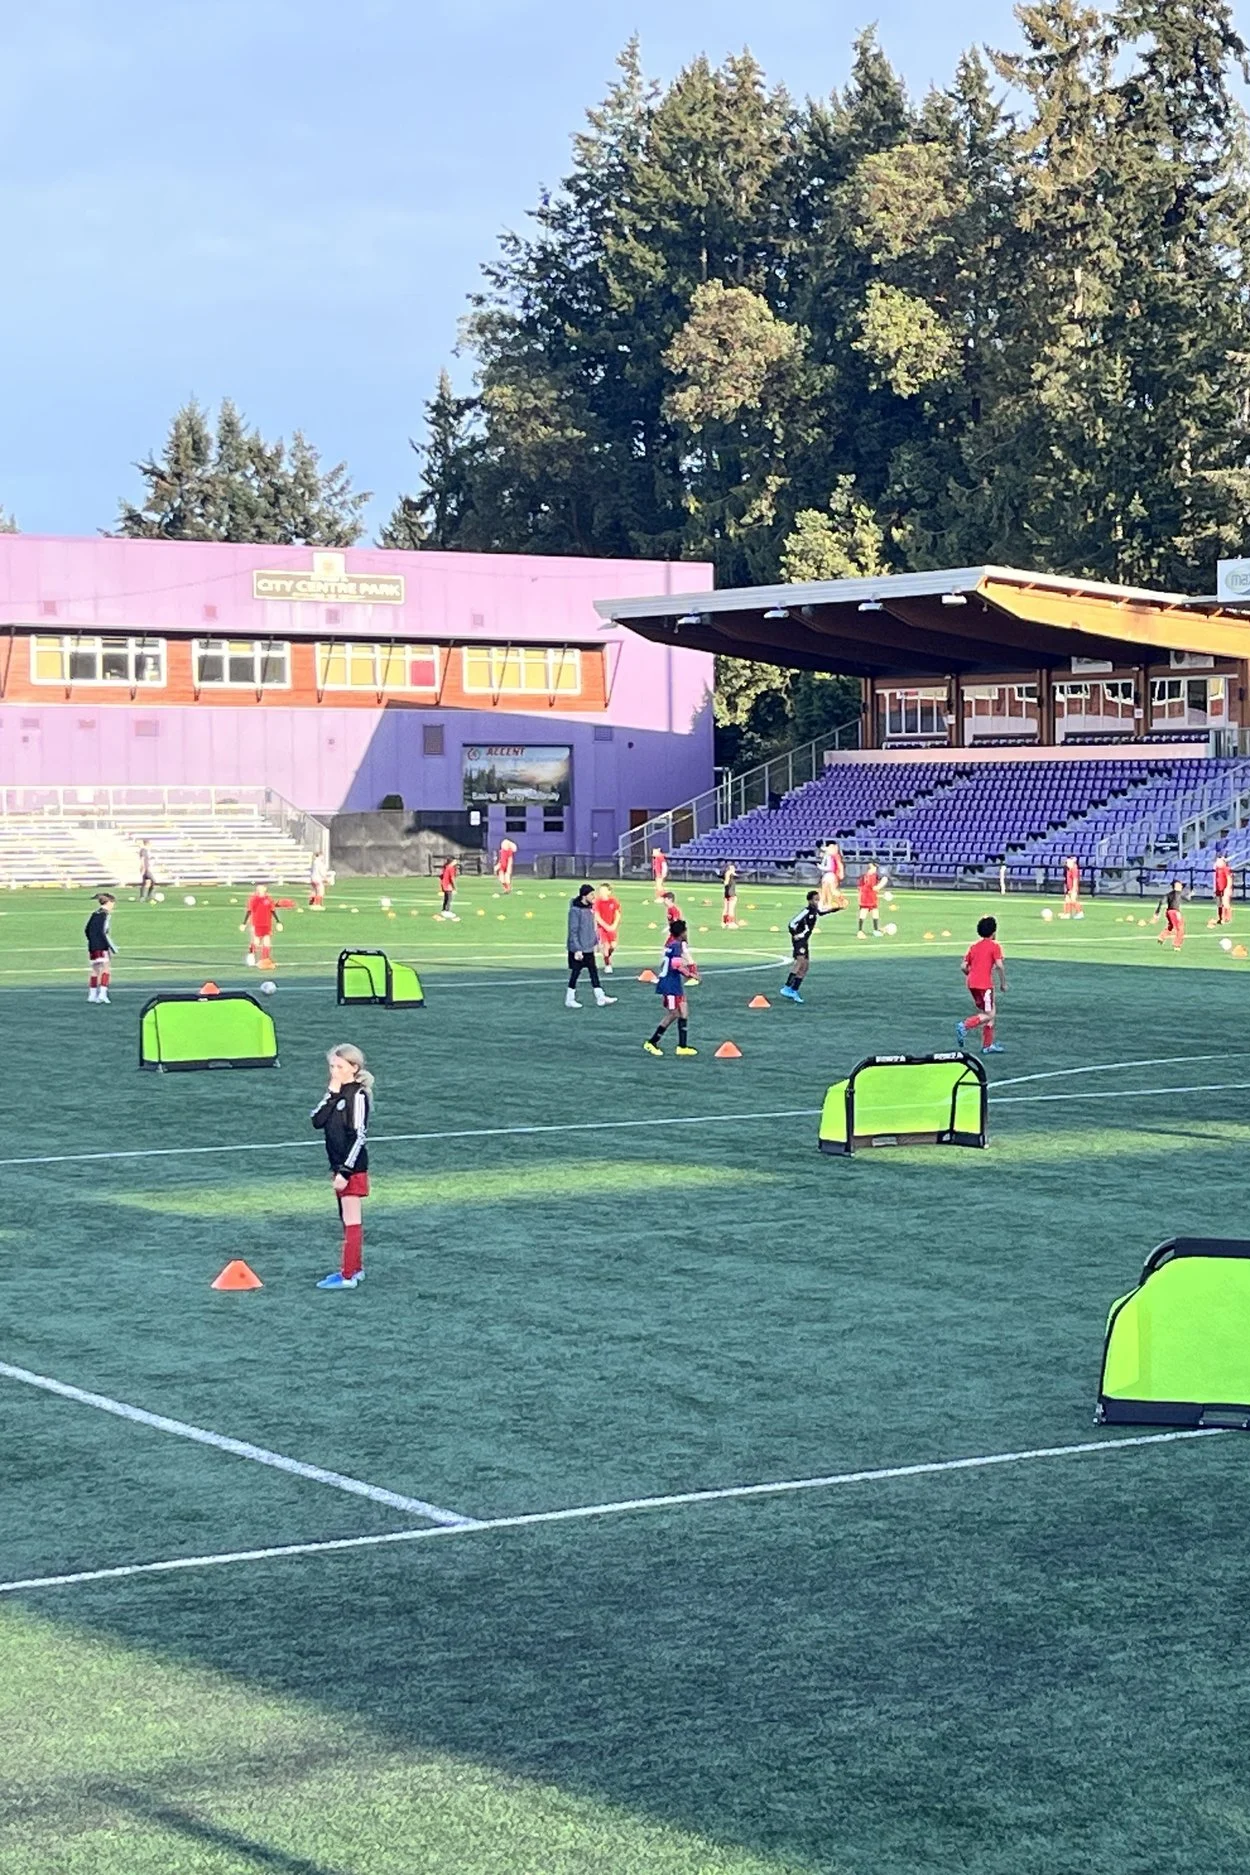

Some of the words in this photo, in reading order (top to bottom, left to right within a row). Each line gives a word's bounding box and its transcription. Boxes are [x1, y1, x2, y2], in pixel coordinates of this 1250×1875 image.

[257, 579, 294, 592] CITY
[295, 580, 357, 595] CENTRE
[359, 582, 401, 597] PARK
